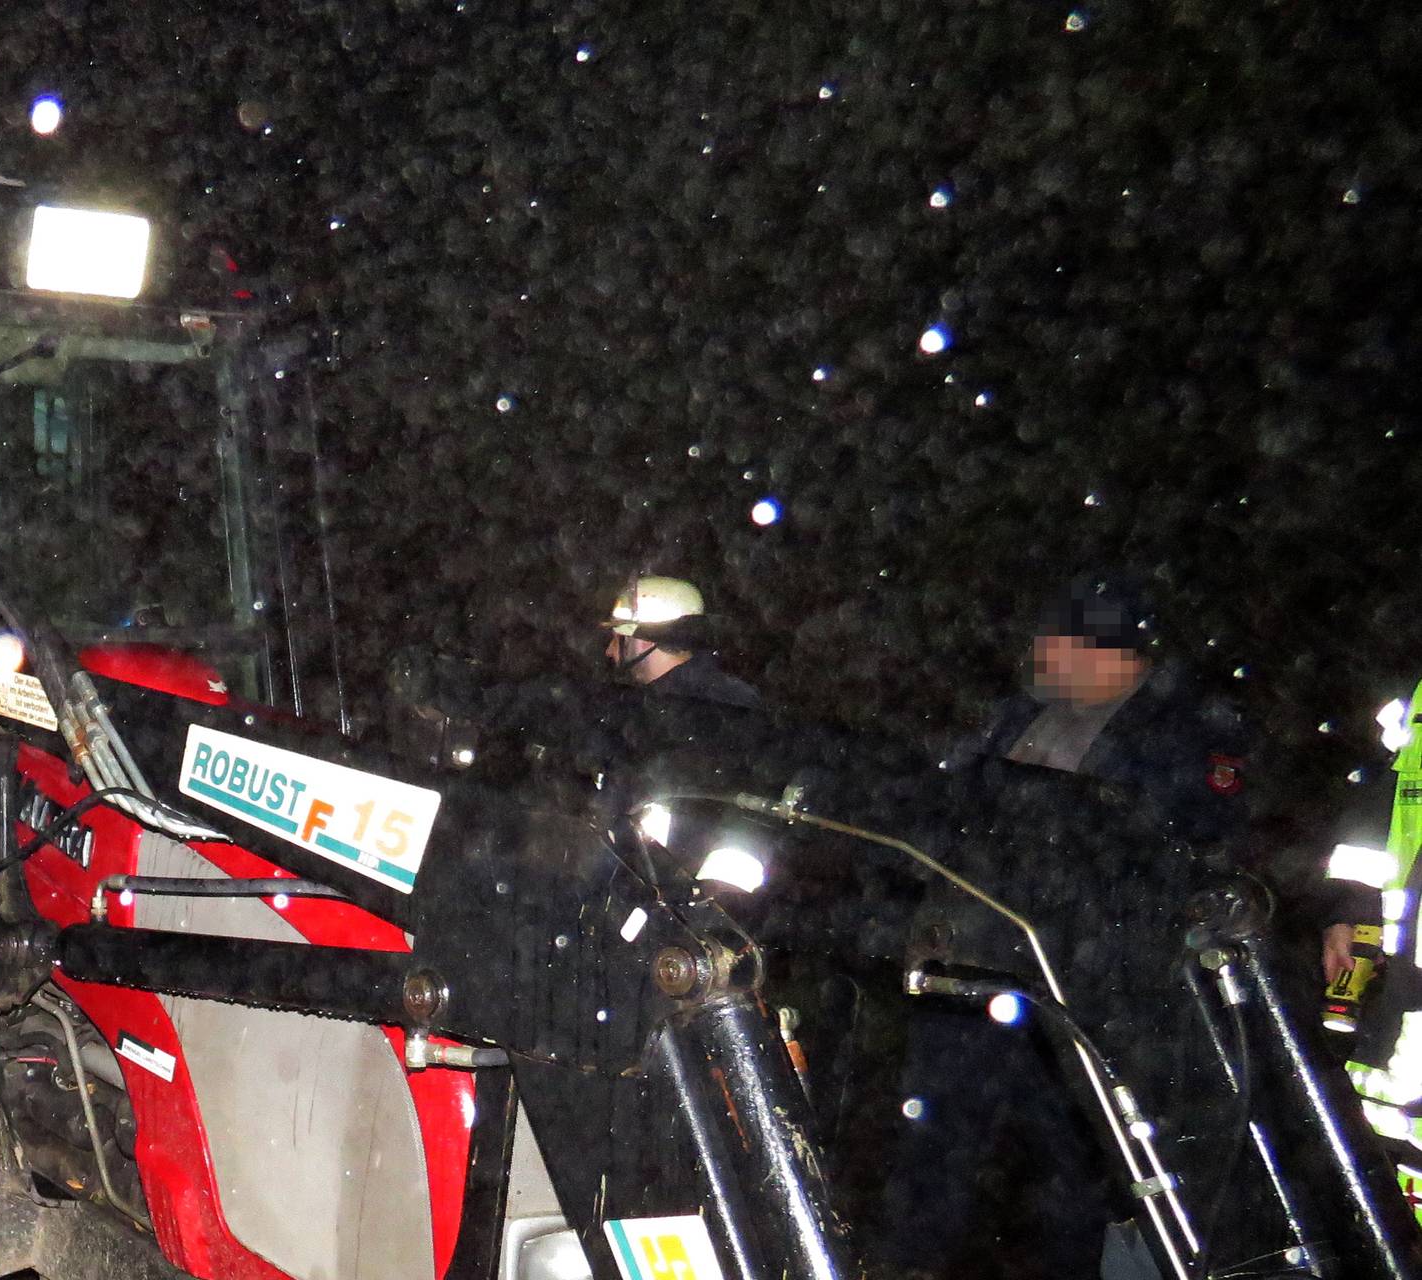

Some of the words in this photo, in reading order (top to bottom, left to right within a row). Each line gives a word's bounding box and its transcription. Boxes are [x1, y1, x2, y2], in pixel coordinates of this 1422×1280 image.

[192, 742, 306, 816] ROBUST
[301, 799, 335, 843] F
[353, 800, 414, 858] 15
